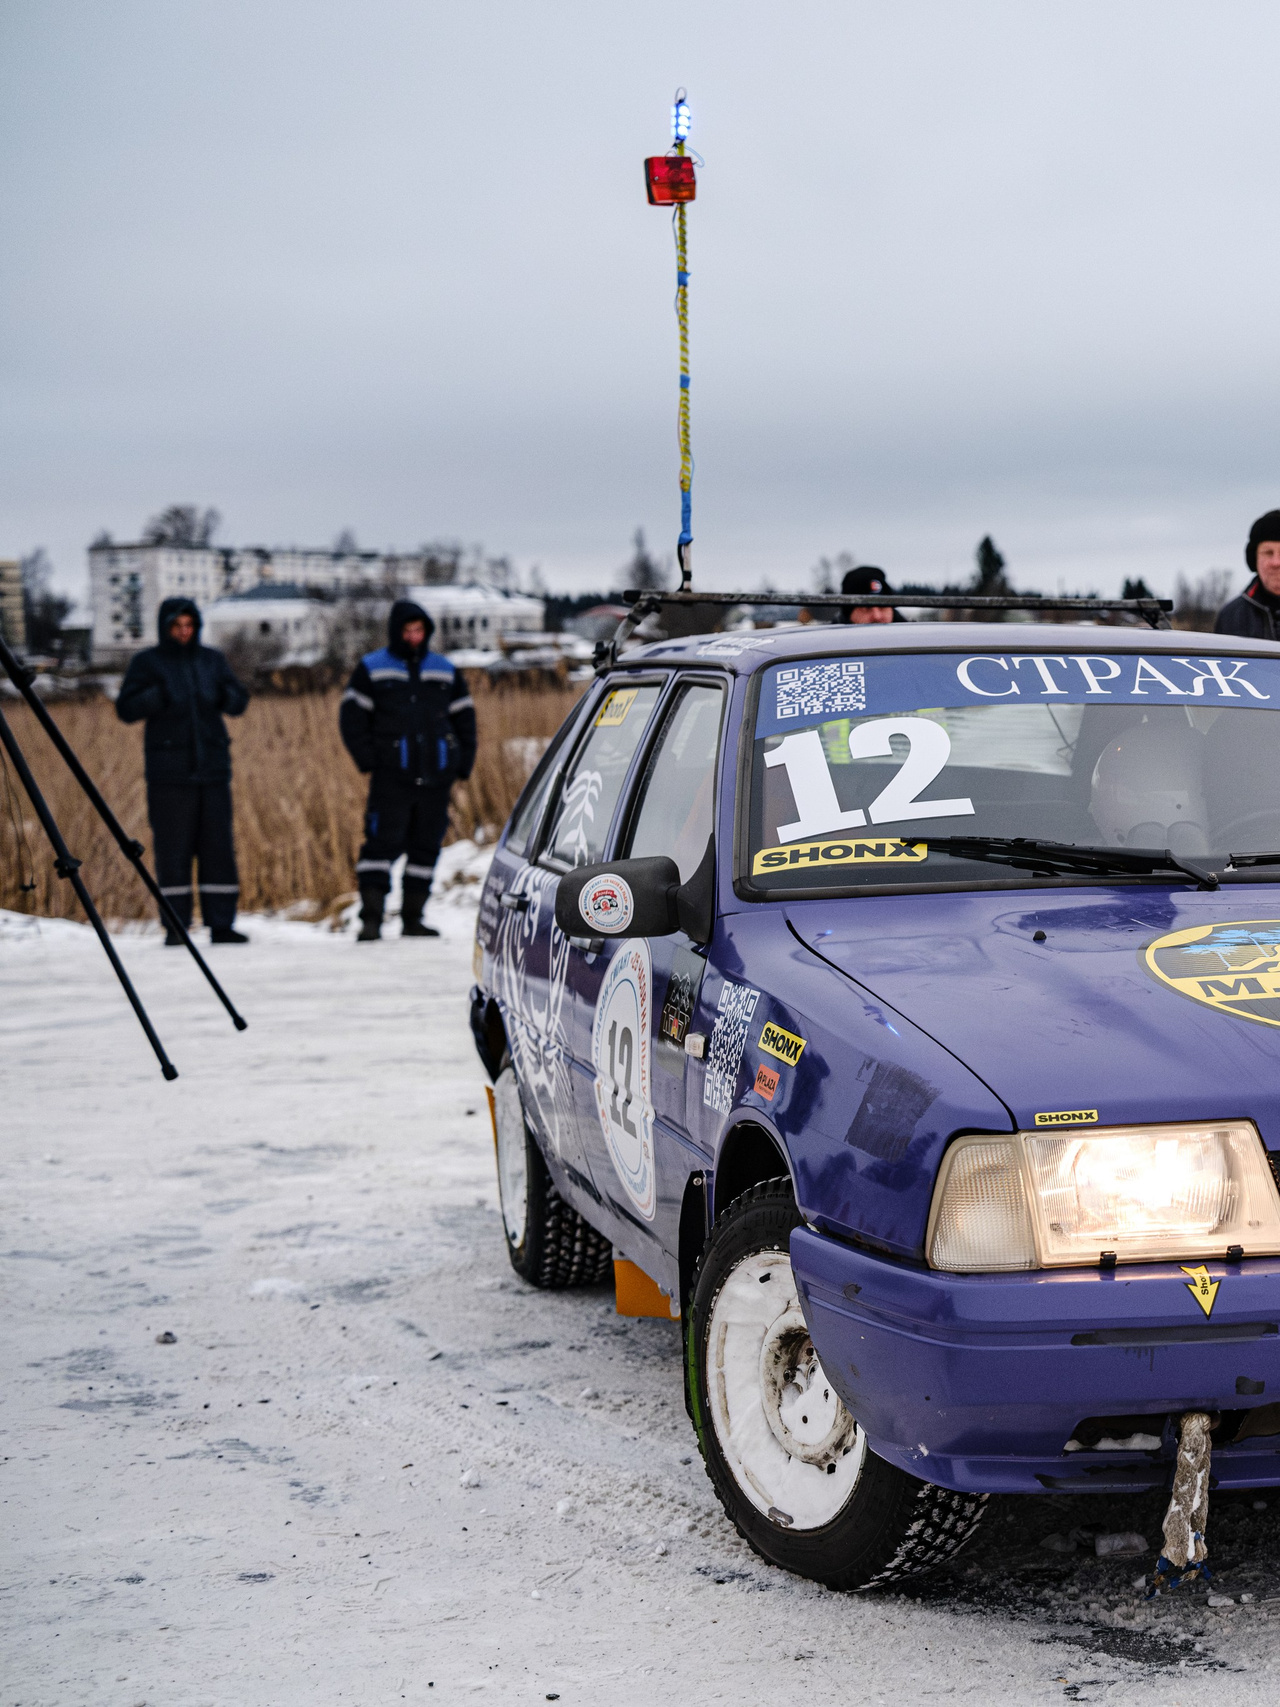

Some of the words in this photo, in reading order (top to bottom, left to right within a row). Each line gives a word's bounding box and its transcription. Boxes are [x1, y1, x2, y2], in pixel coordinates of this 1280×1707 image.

[956, 656, 1271, 700] СТРАЖ
[763, 716, 976, 844] 12
[760, 843, 920, 868] SHONX
[762, 1027, 802, 1061] SHONX
[608, 1020, 637, 1139] 12
[1038, 1112, 1096, 1123] SHONX
